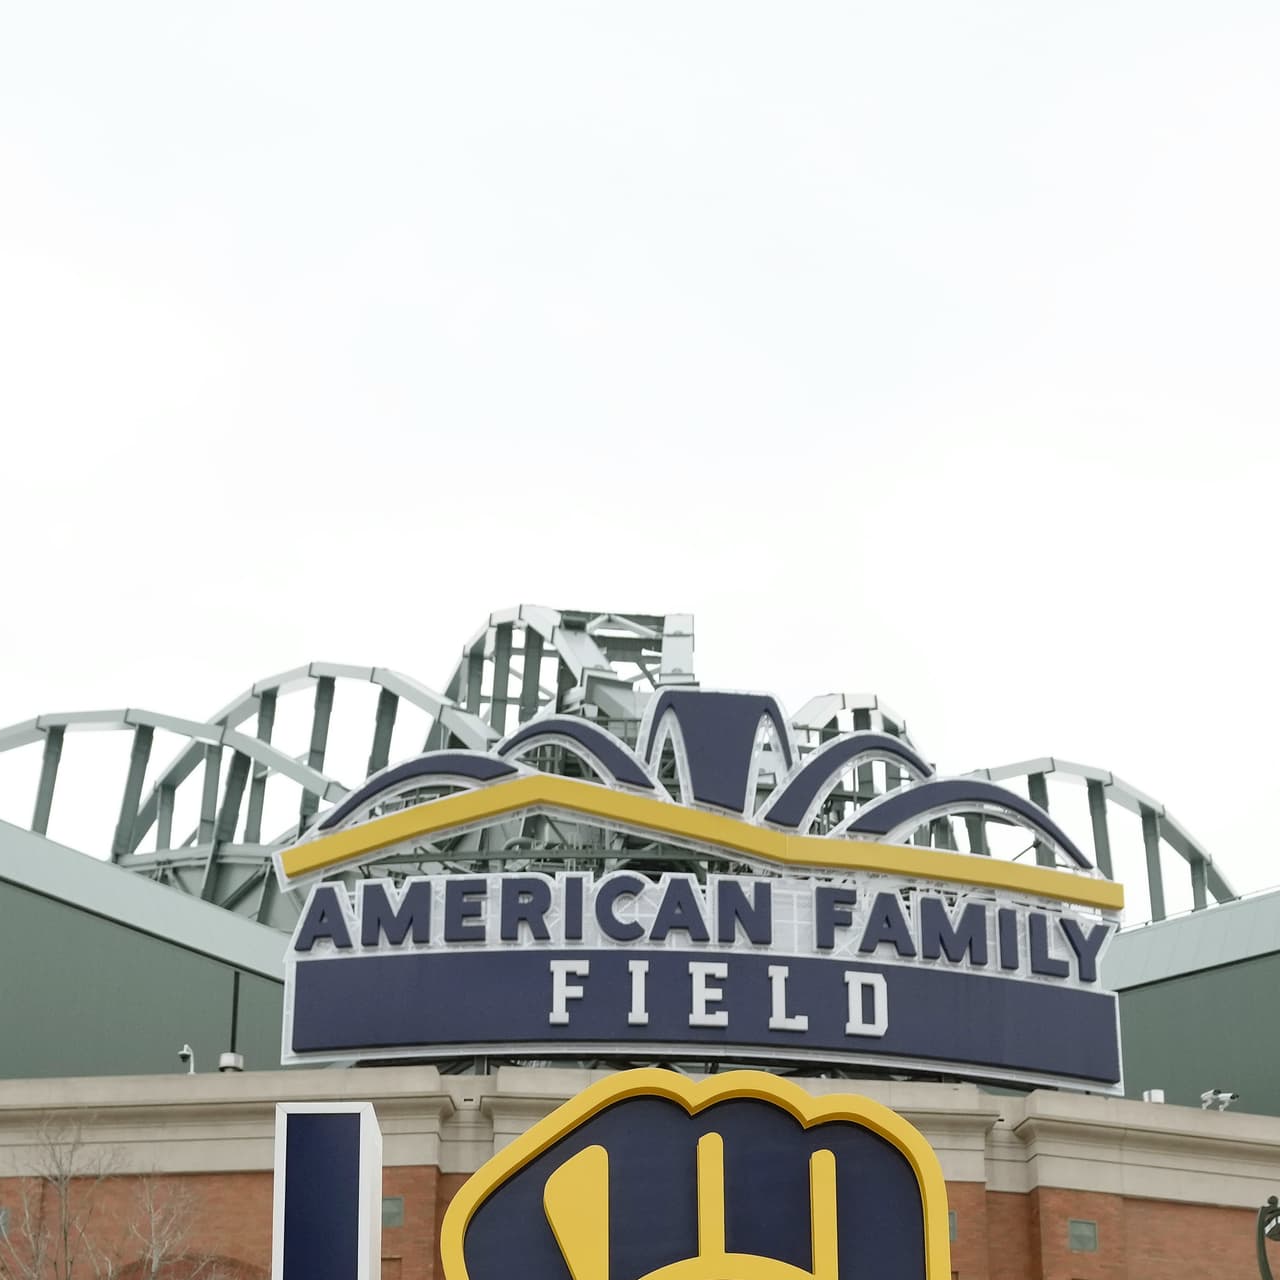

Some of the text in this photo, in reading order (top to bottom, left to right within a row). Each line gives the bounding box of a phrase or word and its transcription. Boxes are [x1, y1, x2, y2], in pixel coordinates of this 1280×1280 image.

[294, 876, 1110, 983] AMERICAN FAMILY
[549, 959, 889, 1038] FIELD
